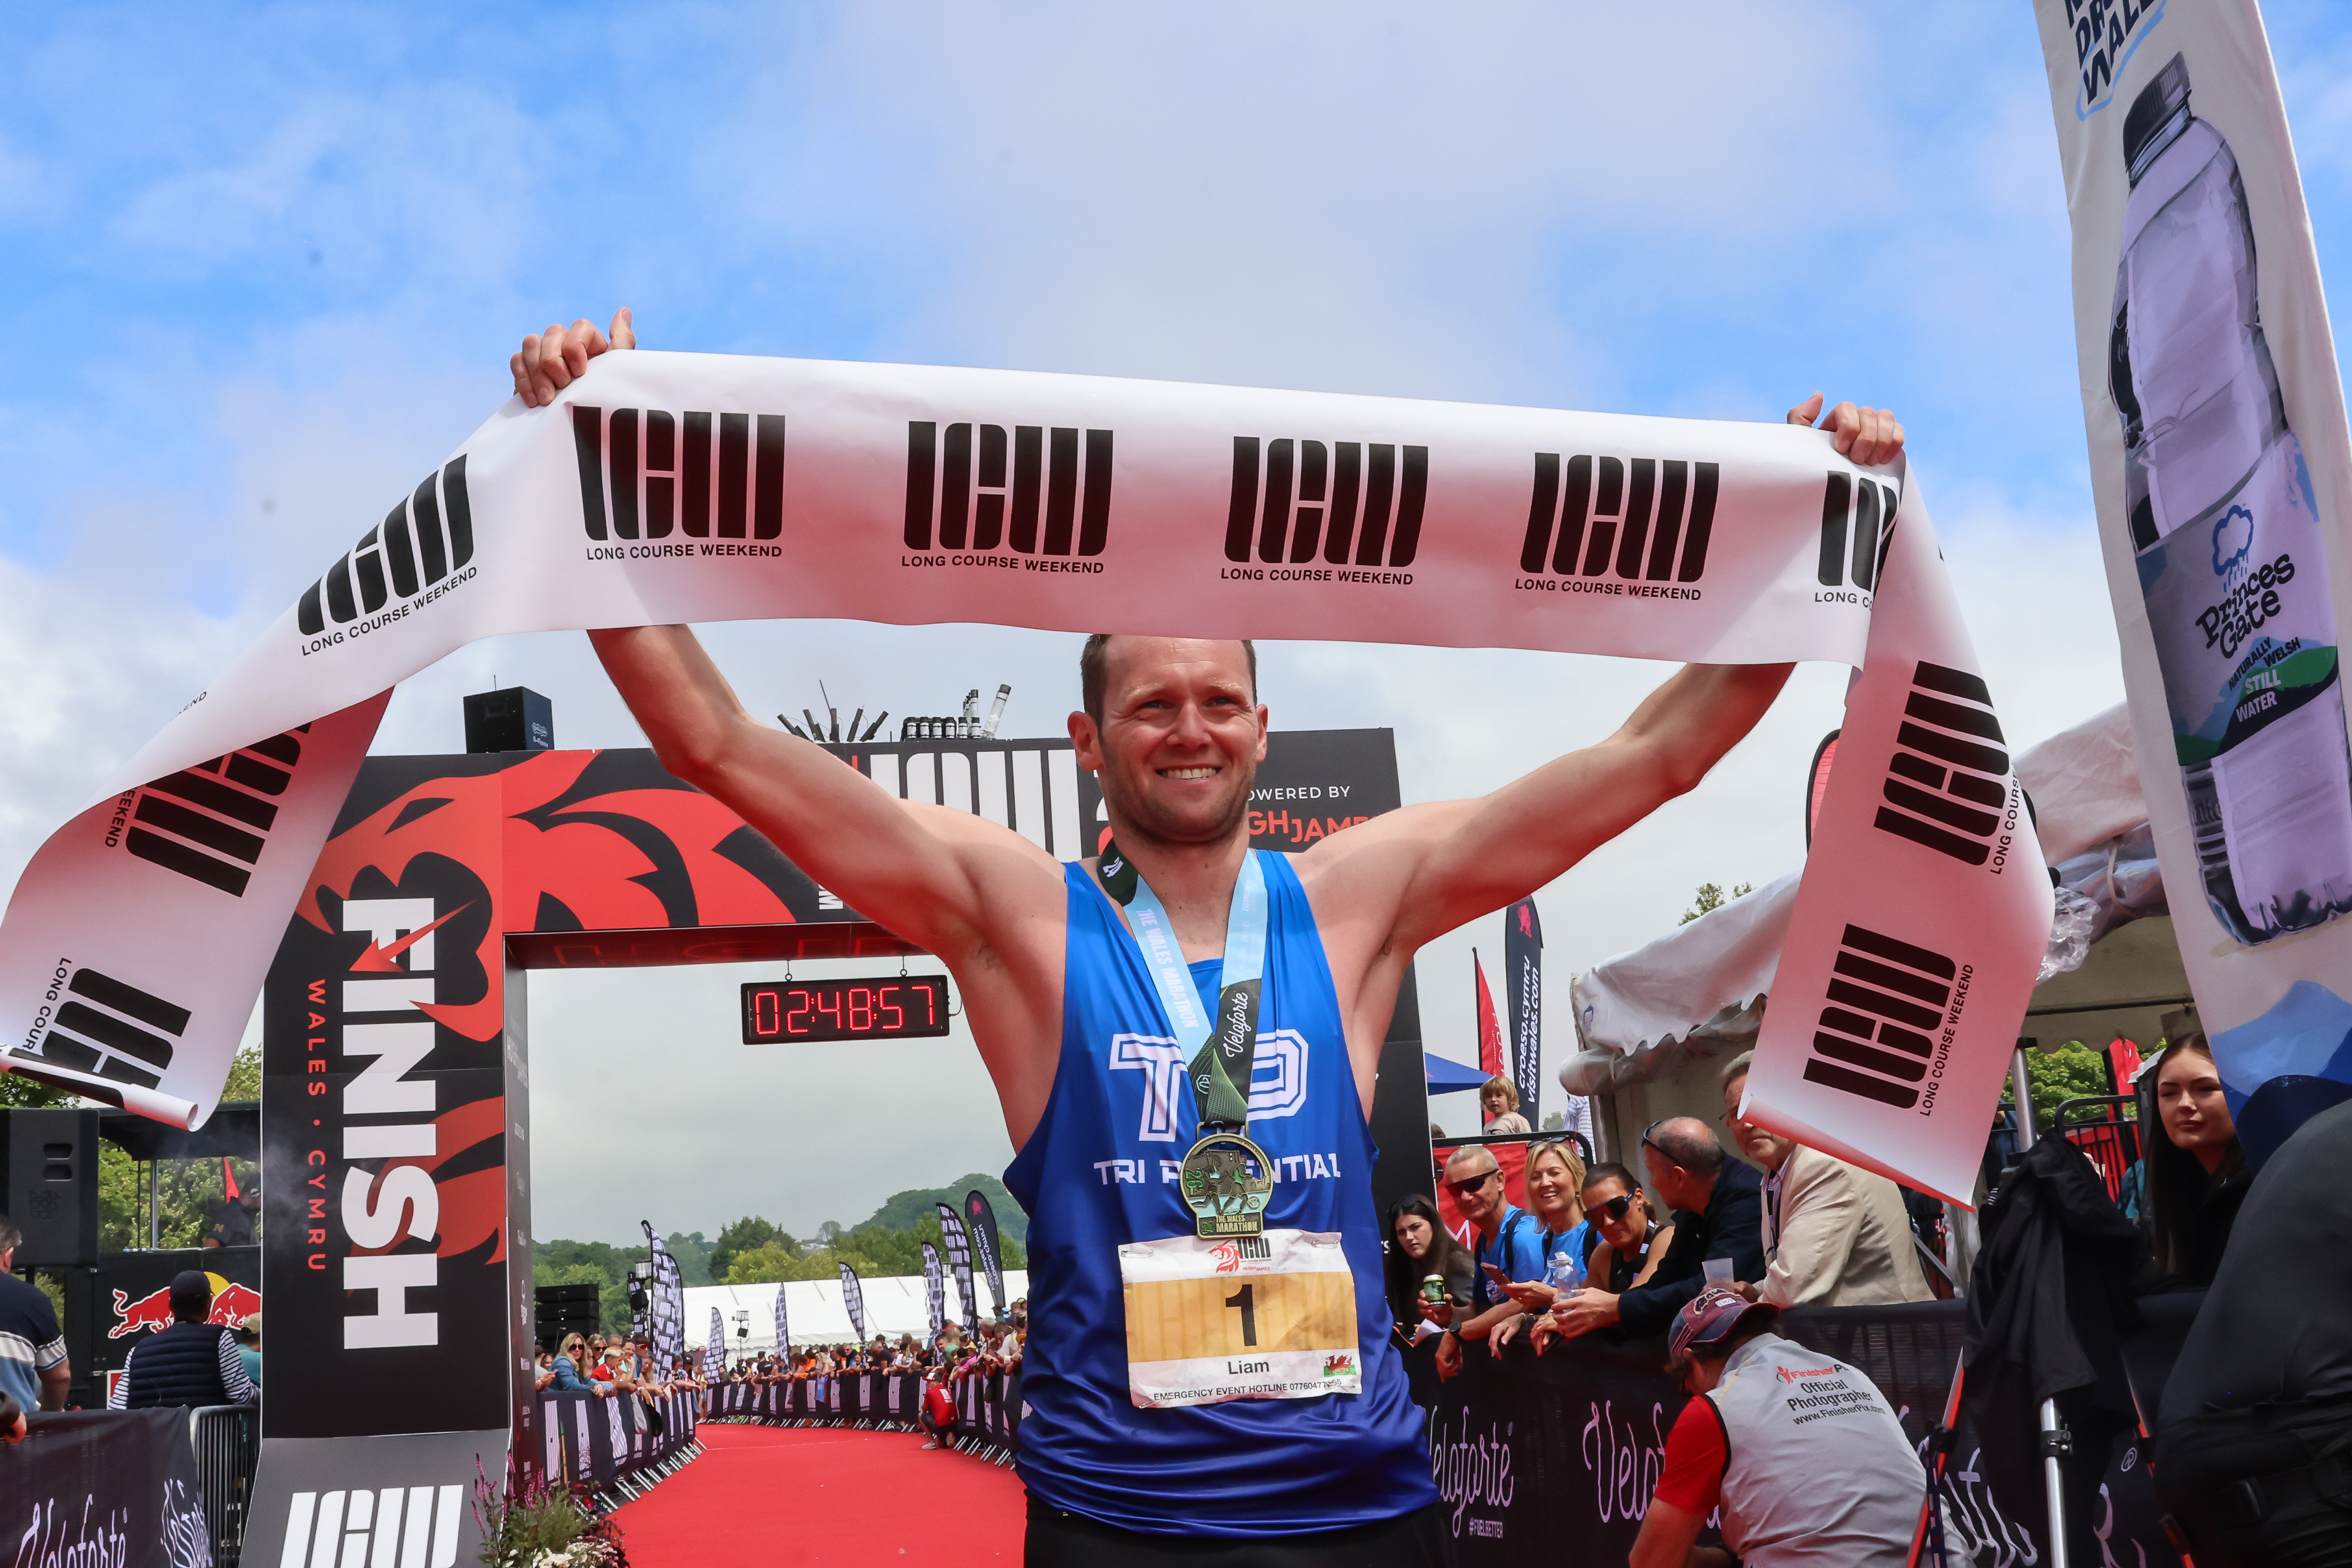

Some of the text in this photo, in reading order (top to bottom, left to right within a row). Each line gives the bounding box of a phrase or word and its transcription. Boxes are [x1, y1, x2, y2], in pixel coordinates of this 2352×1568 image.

[587, 543, 783, 561] LONG COURSE WEEKEND
[901, 555, 1104, 574] LONG COURSE WEEKEND
[1220, 568, 1414, 585] LONG COURSE WEEKEND
[1514, 578, 1702, 601] LONG COURSE WEEKEND
[301, 566, 478, 656] LONG COURSE WEEKEND
[1814, 592, 1858, 605] LONG
[2195, 554, 2296, 649] Princes
[2219, 589, 2282, 659] Gate
[2228, 636, 2273, 692] NATURALLY
[2262, 636, 2302, 668] WELSH
[2245, 669, 2282, 696] STILL
[2236, 691, 2277, 723] WATER
[1328, 785, 1351, 798] BY
[104, 788, 138, 848] EEKEND
[1989, 834, 2012, 875] LONG
[1136, 907, 1200, 1029] THE WALES MARATHON
[21, 957, 72, 1051] LONG COUR
[755, 985, 934, 1035] 02:48:57
[1223, 991, 1249, 1058] Veloforte
[1519, 955, 1530, 1090] croeso.cymru
[1528, 967, 1539, 1104] visitwales.com
[1920, 964, 1974, 1116] LONG COURSE WEEKEND
[308, 979, 326, 1270] WALES CYMRU
[341, 897, 439, 1350] FINISH
[1093, 1159, 1145, 1185] TRI
[1216, 1214, 1245, 1223] THE WALES
[1216, 1221, 1258, 1233] MARATHON
[1225, 1284, 1257, 1347] 1
[1227, 1360, 1270, 1375] Liam
[1801, 1379, 1849, 1394] Official
[1154, 1379, 1342, 1401] EMERGENCY EVENT HOTLINE 0776047755
[1787, 1390, 1874, 1411] Photographer
[1430, 1405, 1513, 1538] eloforte
